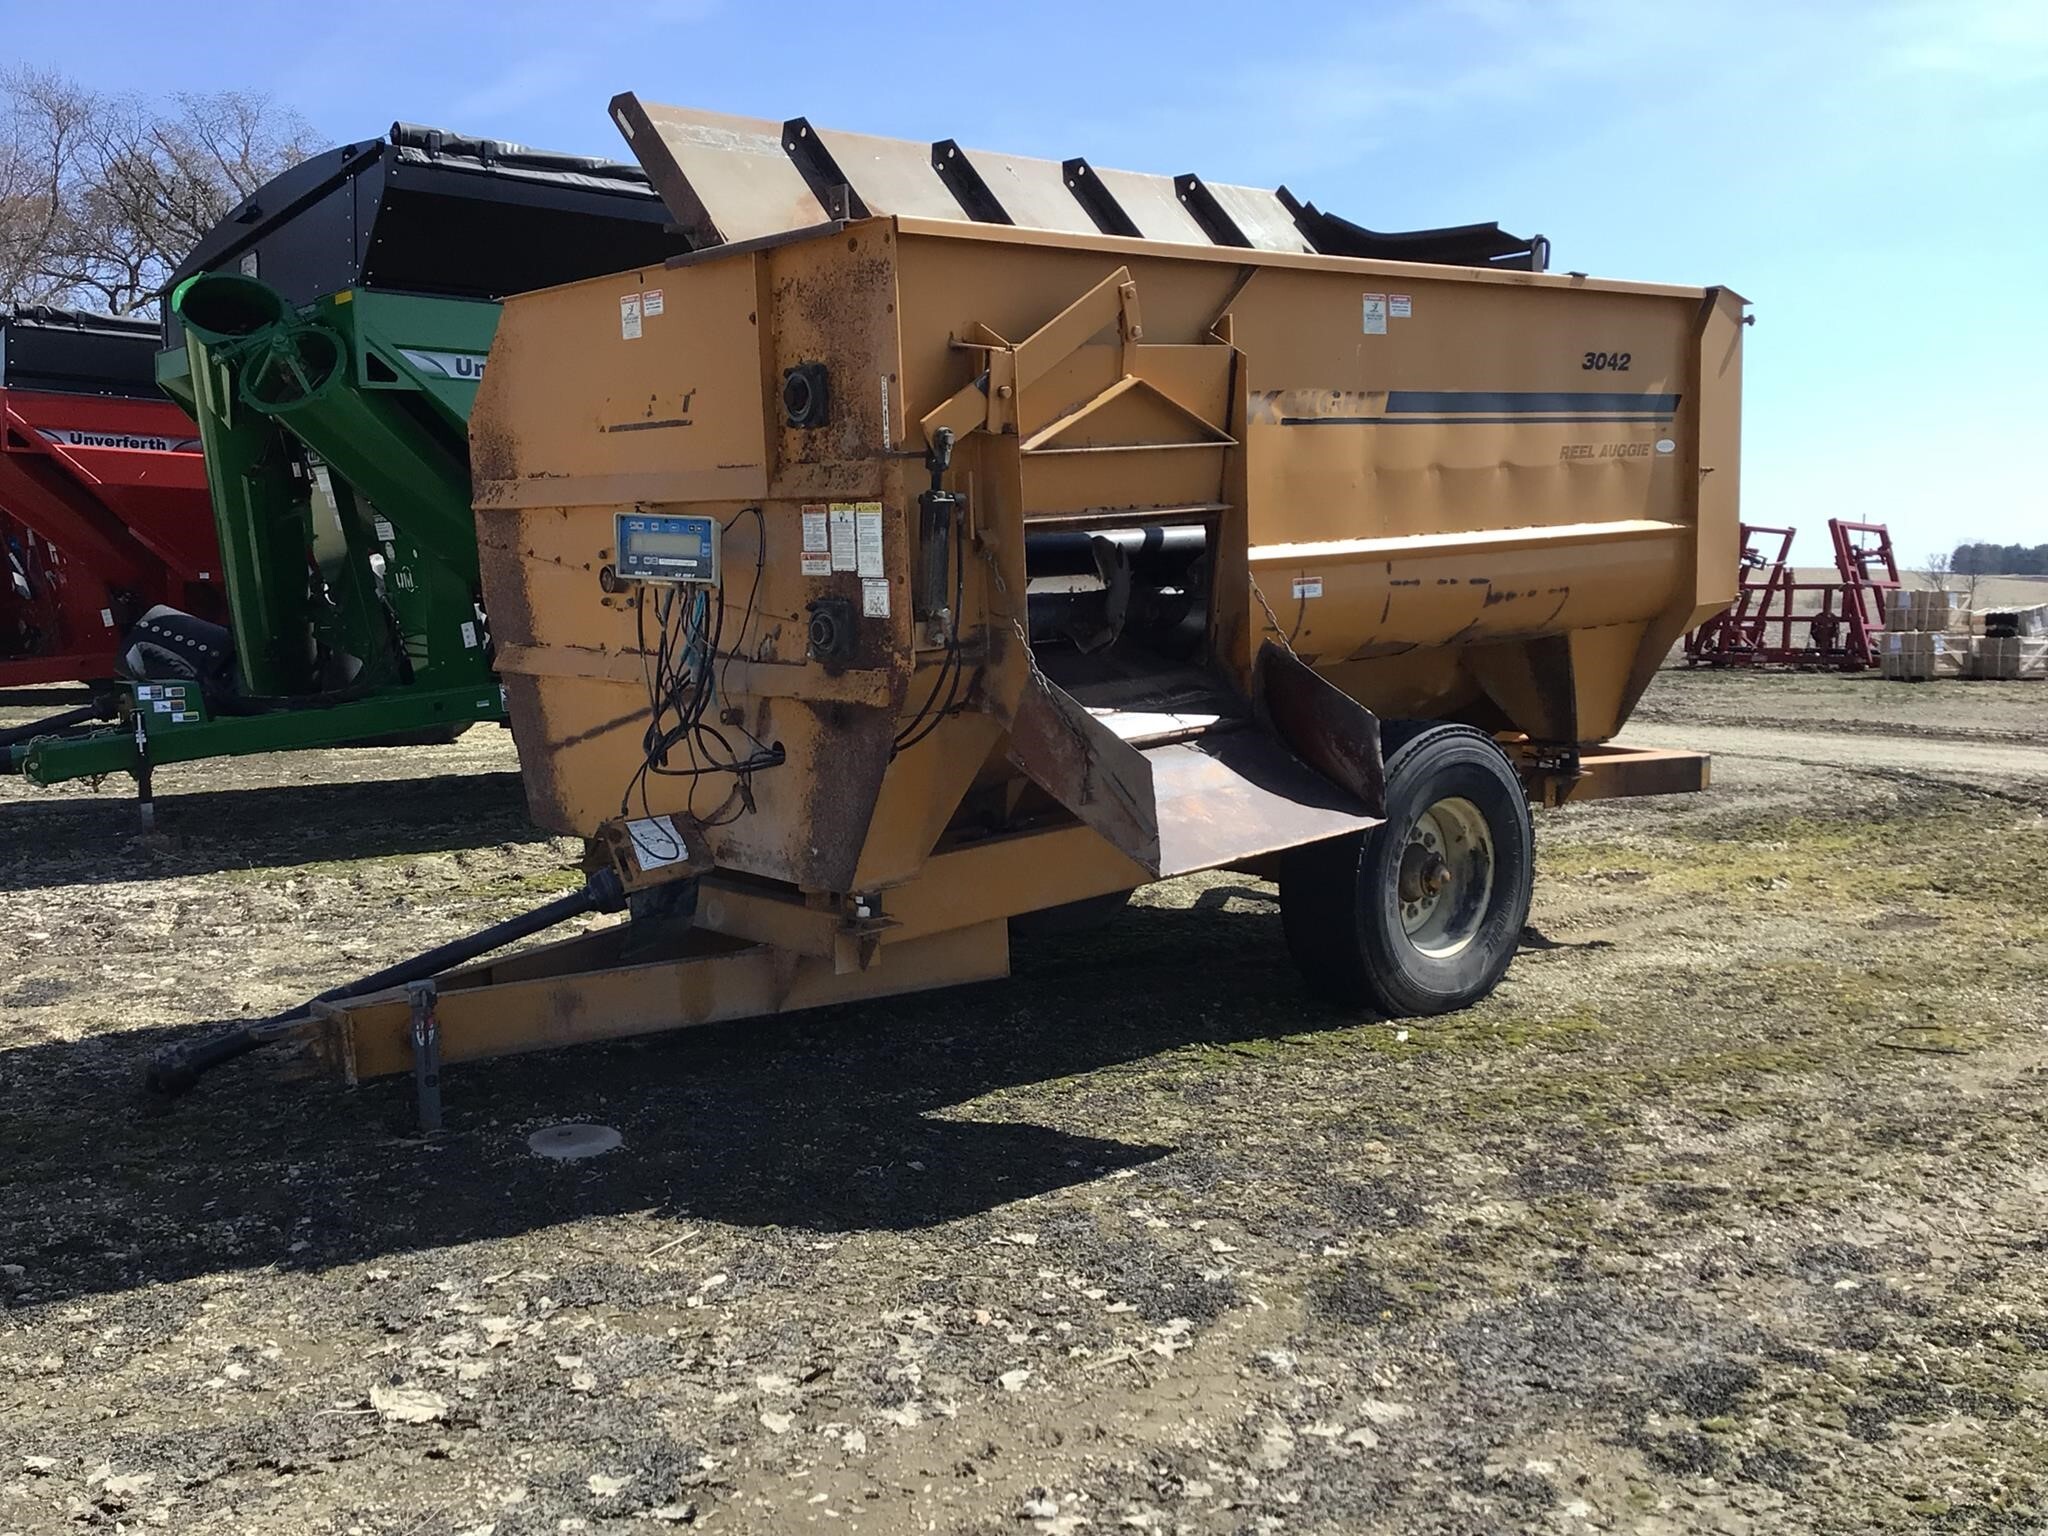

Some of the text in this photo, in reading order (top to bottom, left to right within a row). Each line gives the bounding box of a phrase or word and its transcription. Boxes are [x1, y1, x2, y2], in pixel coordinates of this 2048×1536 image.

[1582, 352, 1632, 371] 3042
[69, 432, 167, 451] Unverferth
[1560, 445, 1595, 459] REEL
[1599, 443, 1651, 457] AUGGIE
